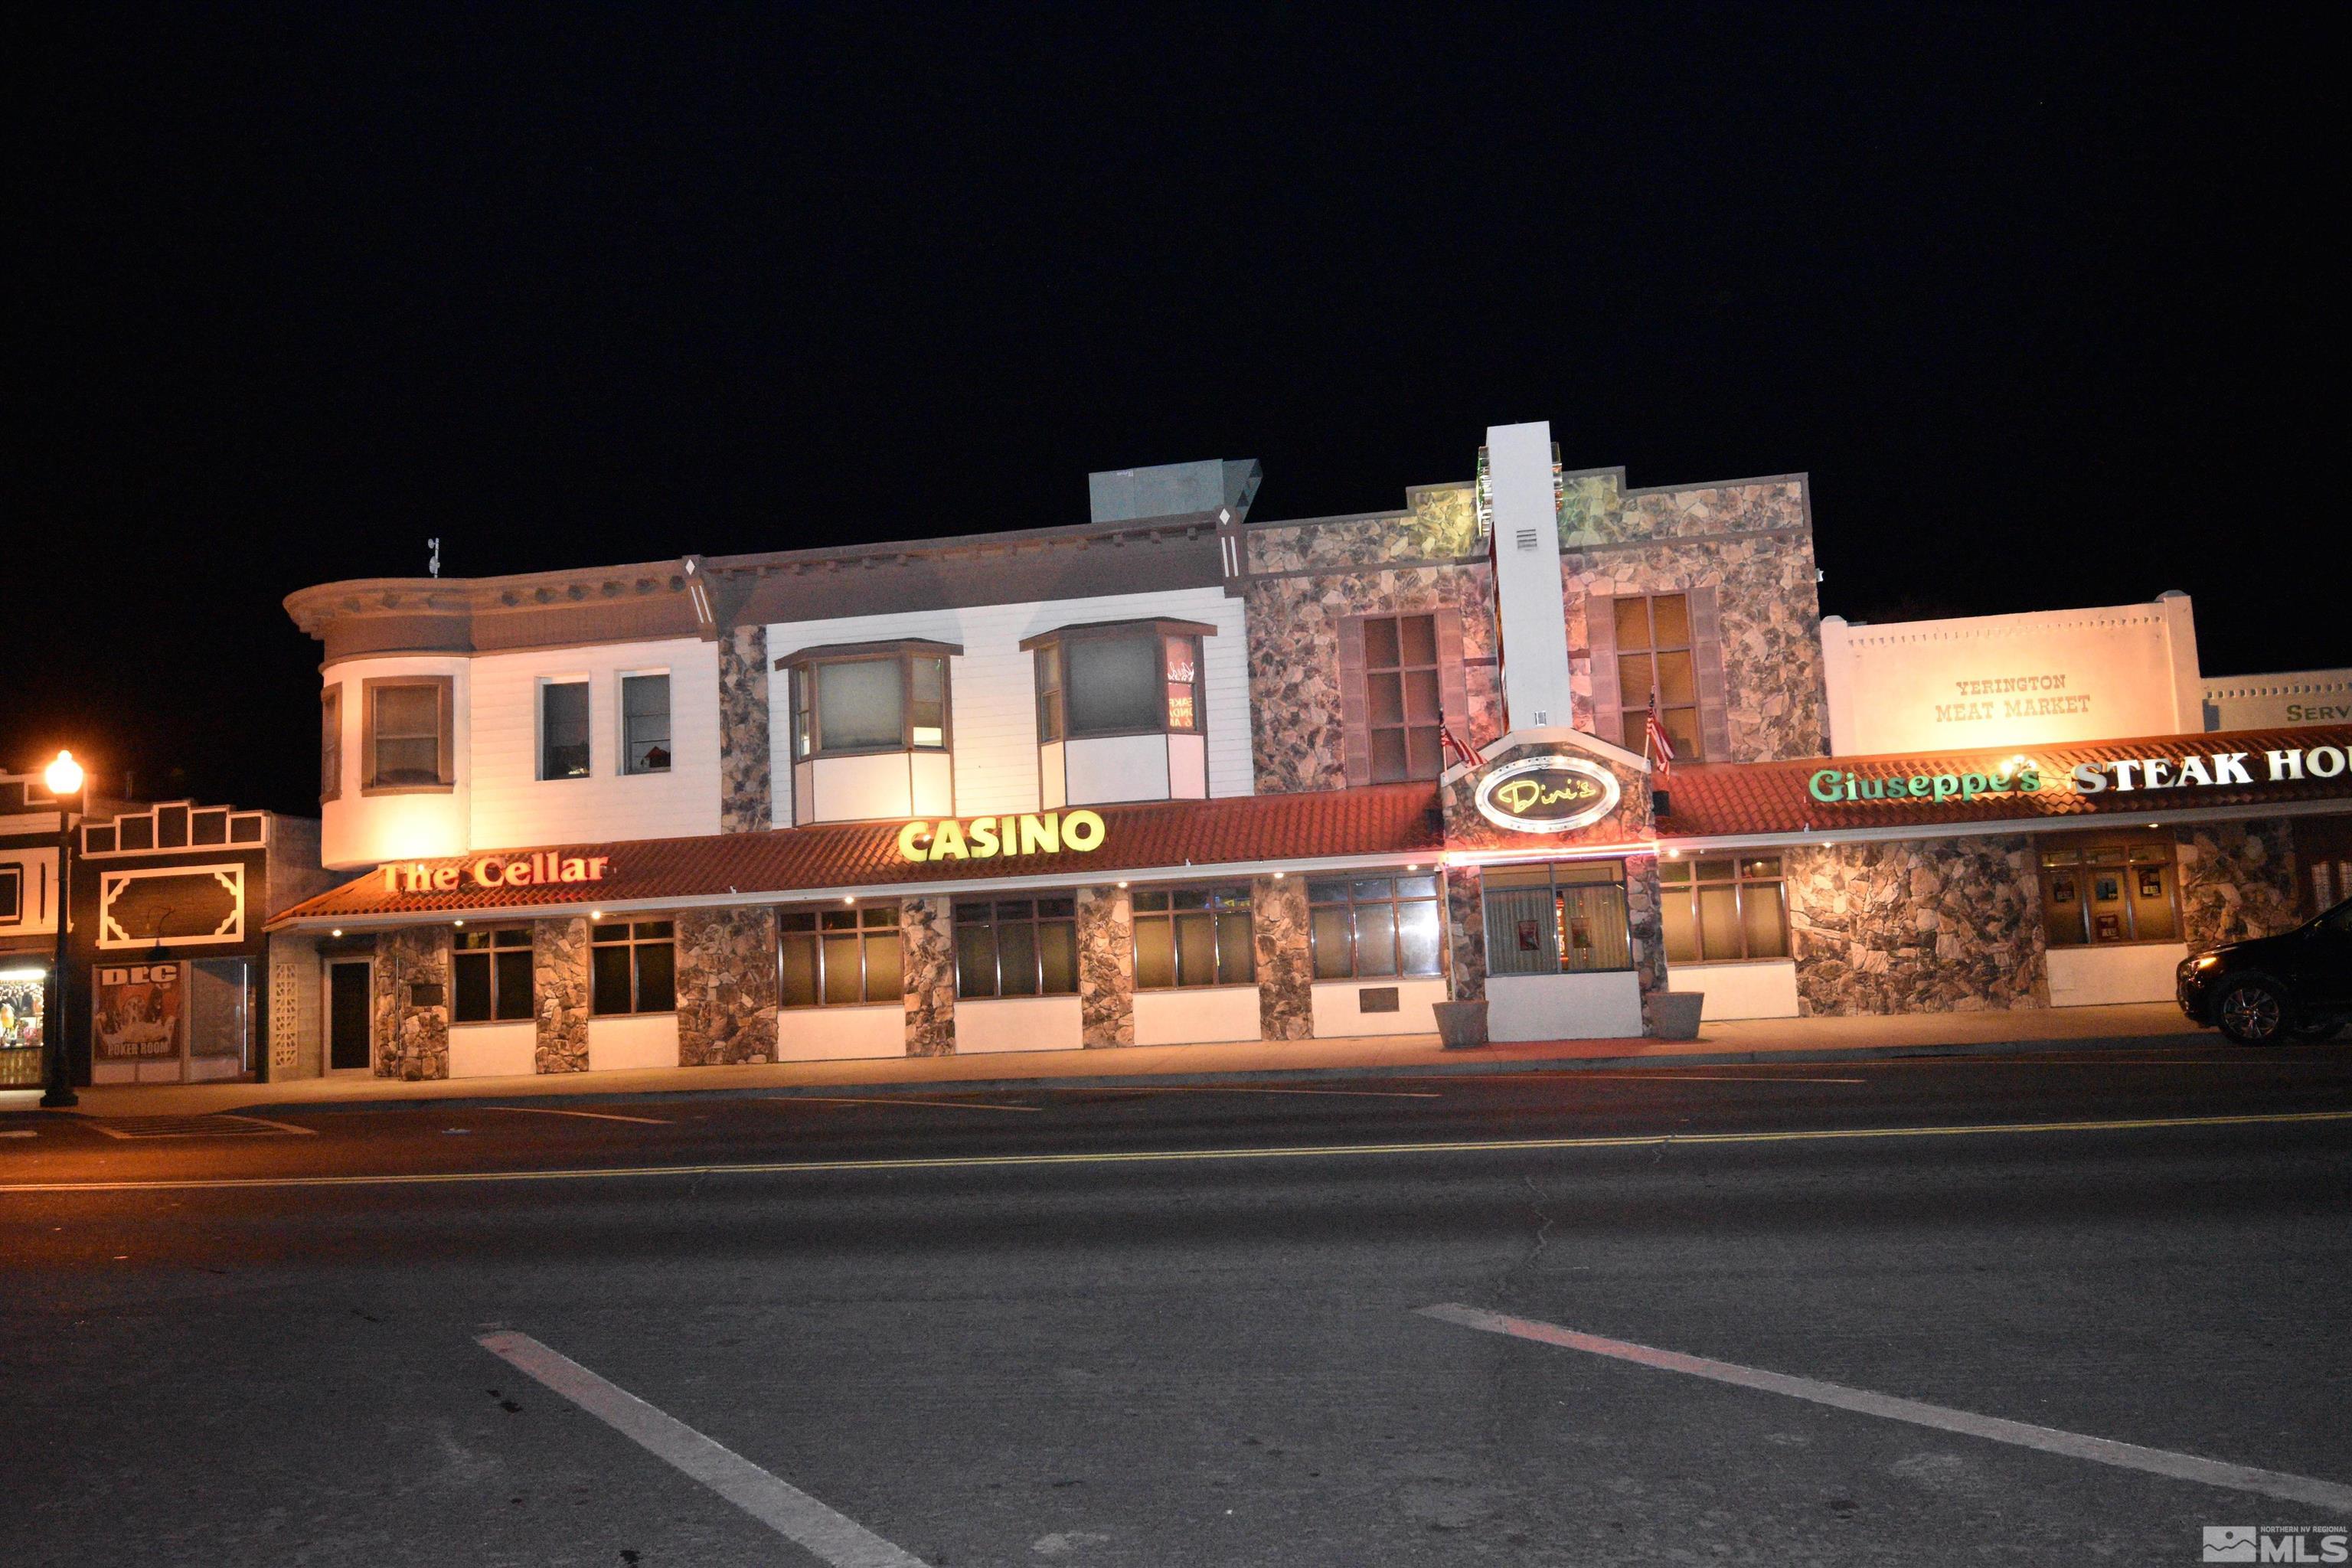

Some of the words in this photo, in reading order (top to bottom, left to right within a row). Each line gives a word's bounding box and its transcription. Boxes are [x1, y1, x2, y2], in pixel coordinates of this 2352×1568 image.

[1956, 674, 2066, 695] YERINGTON
[1936, 701, 1994, 723] MEAT
[2004, 694, 2090, 717] MARKET
[2286, 704, 2351, 721] SERV
[1809, 769, 2041, 803] Giuseppe's
[2072, 751, 2253, 794] STEAK
[2265, 746, 2352, 780] HO
[1498, 778, 1596, 814] Dini's
[898, 809, 1106, 862] CASINO
[379, 863, 459, 893] The
[474, 851, 609, 887] Cellar
[108, 1043, 138, 1055] POKER
[140, 1041, 168, 1054] ROOM
